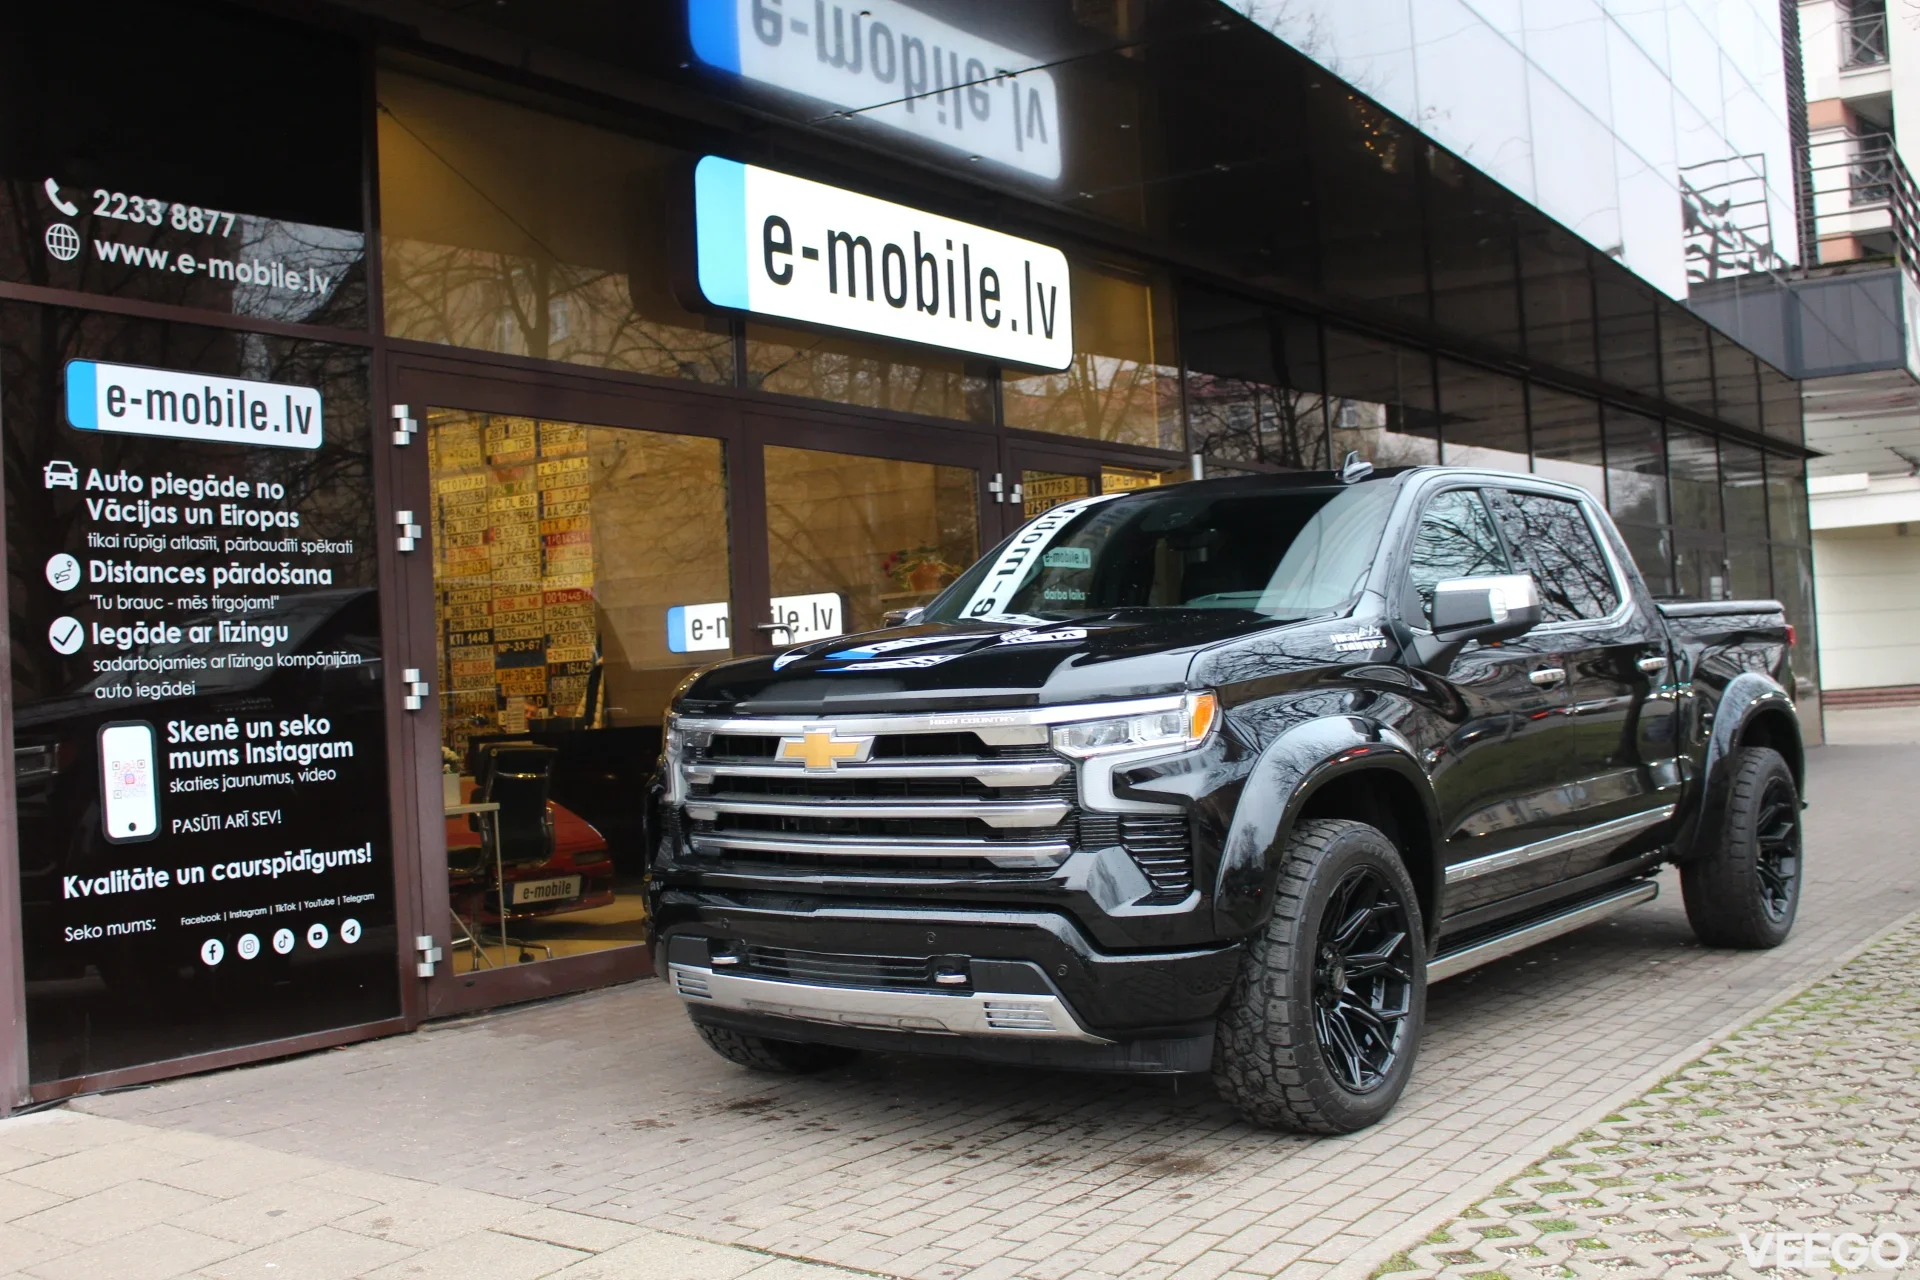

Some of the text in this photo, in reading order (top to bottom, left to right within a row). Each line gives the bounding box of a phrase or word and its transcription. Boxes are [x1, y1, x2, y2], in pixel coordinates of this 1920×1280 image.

[93, 188, 237, 239] 2233 8877
[93, 239, 331, 294] www.e-mobile.lv
[763, 214, 1057, 340] e-mobile.lv
[106, 383, 312, 435] e-mobile.lv
[85, 468, 285, 501] Auto piegāde no
[86, 498, 300, 531] Vācijas un Eiropas
[87, 532, 120, 549] tikai
[123, 534, 167, 552] rūpīgi
[225, 537, 298, 554] pārbaudīti
[301, 537, 353, 555] spēkrati
[89, 559, 333, 590] Distances pārdošana
[117, 595, 165, 610] brauc
[177, 594, 209, 610] mēs
[91, 620, 289, 651] Iegāde ar līzingu
[93, 651, 362, 673] sadarbojamies ar līzinga kompānijām
[95, 681, 196, 701] auto iegādei
[167, 714, 331, 744] Skenē un seko
[169, 740, 354, 770] mums Instagram
[169, 766, 337, 793] skaties jaunumus, video
[172, 808, 282, 834] PASŪTI ARĪ SEV!
[63, 842, 373, 899] Kvalitāte un caurspīdīgums!
[523, 880, 572, 900] e-mobile
[181, 892, 375, 926] Facebook Instagram TikTok YouTube Telegram
[64, 918, 157, 943] Seko mums:
